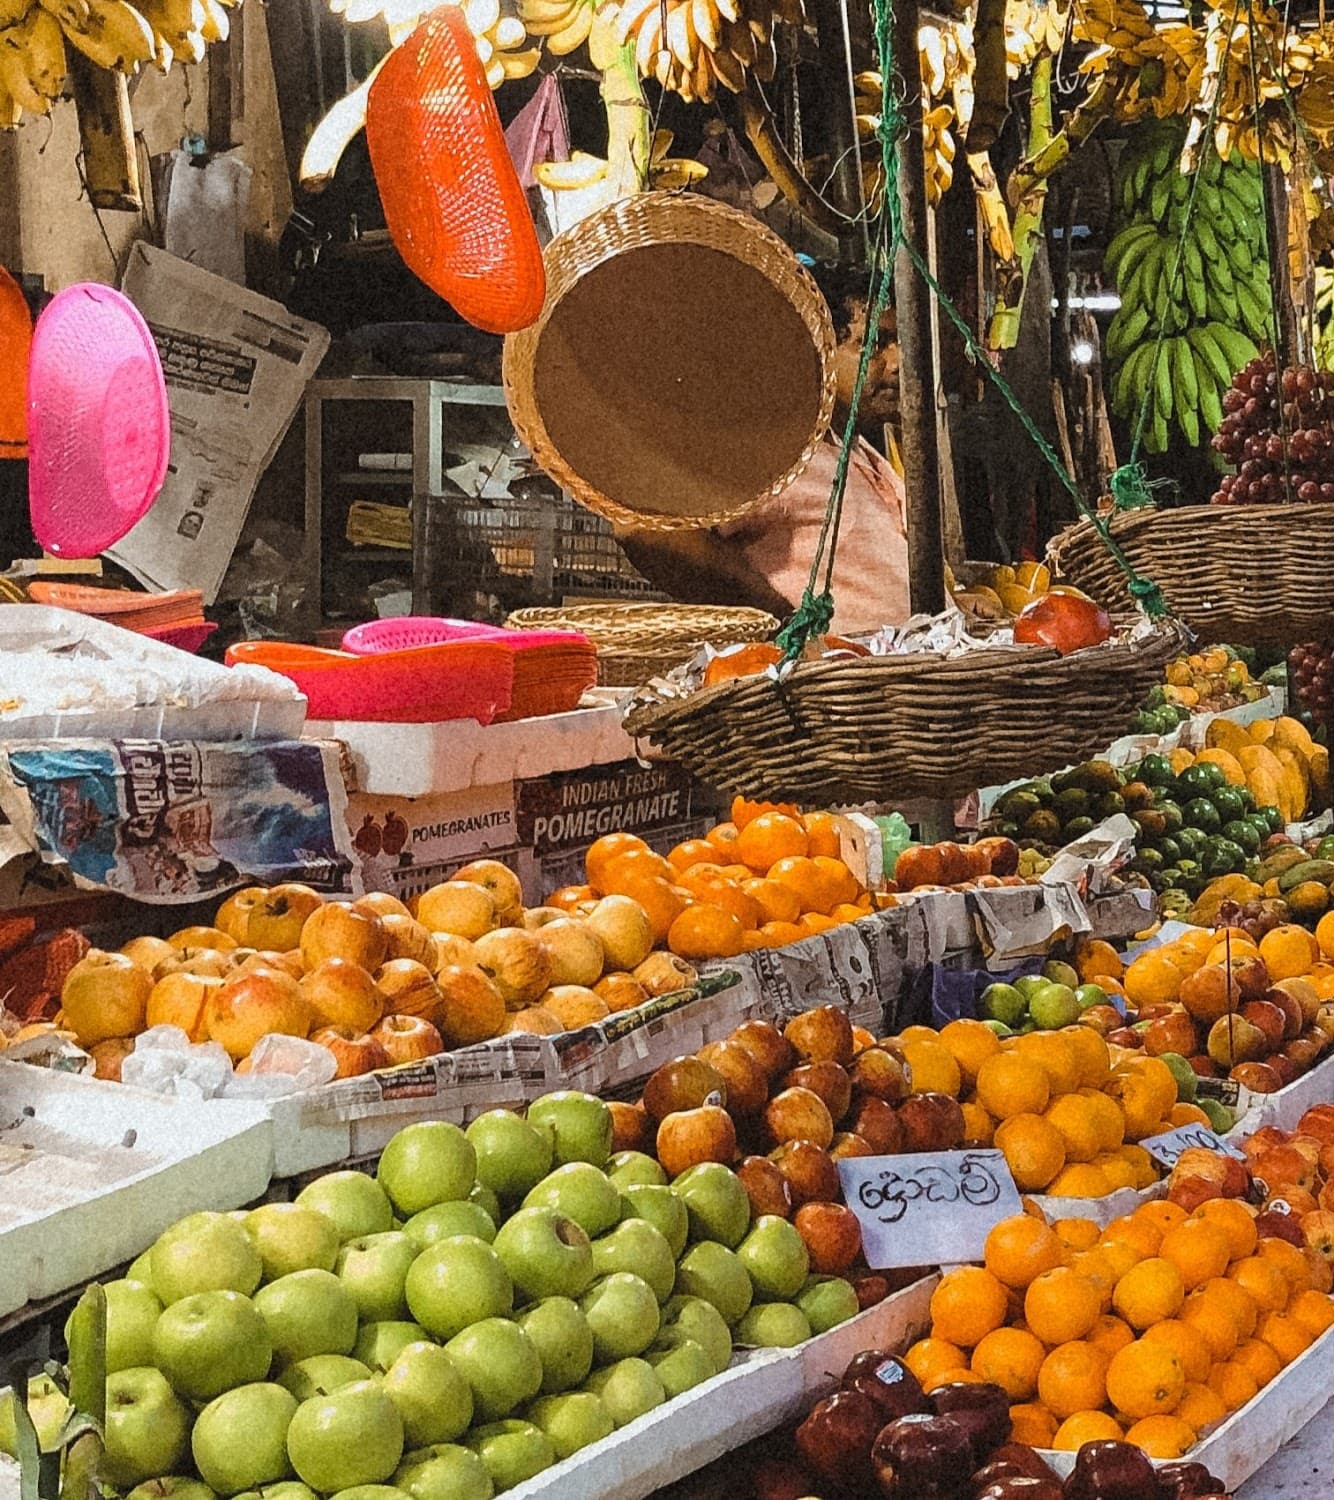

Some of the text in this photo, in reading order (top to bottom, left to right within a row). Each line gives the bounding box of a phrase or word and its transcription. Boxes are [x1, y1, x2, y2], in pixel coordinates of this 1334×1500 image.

[562, 770, 667, 808] INDIAN FRESH
[411, 810, 512, 843] POMEGRANATES
[533, 789, 680, 845] POMEGRANATE
